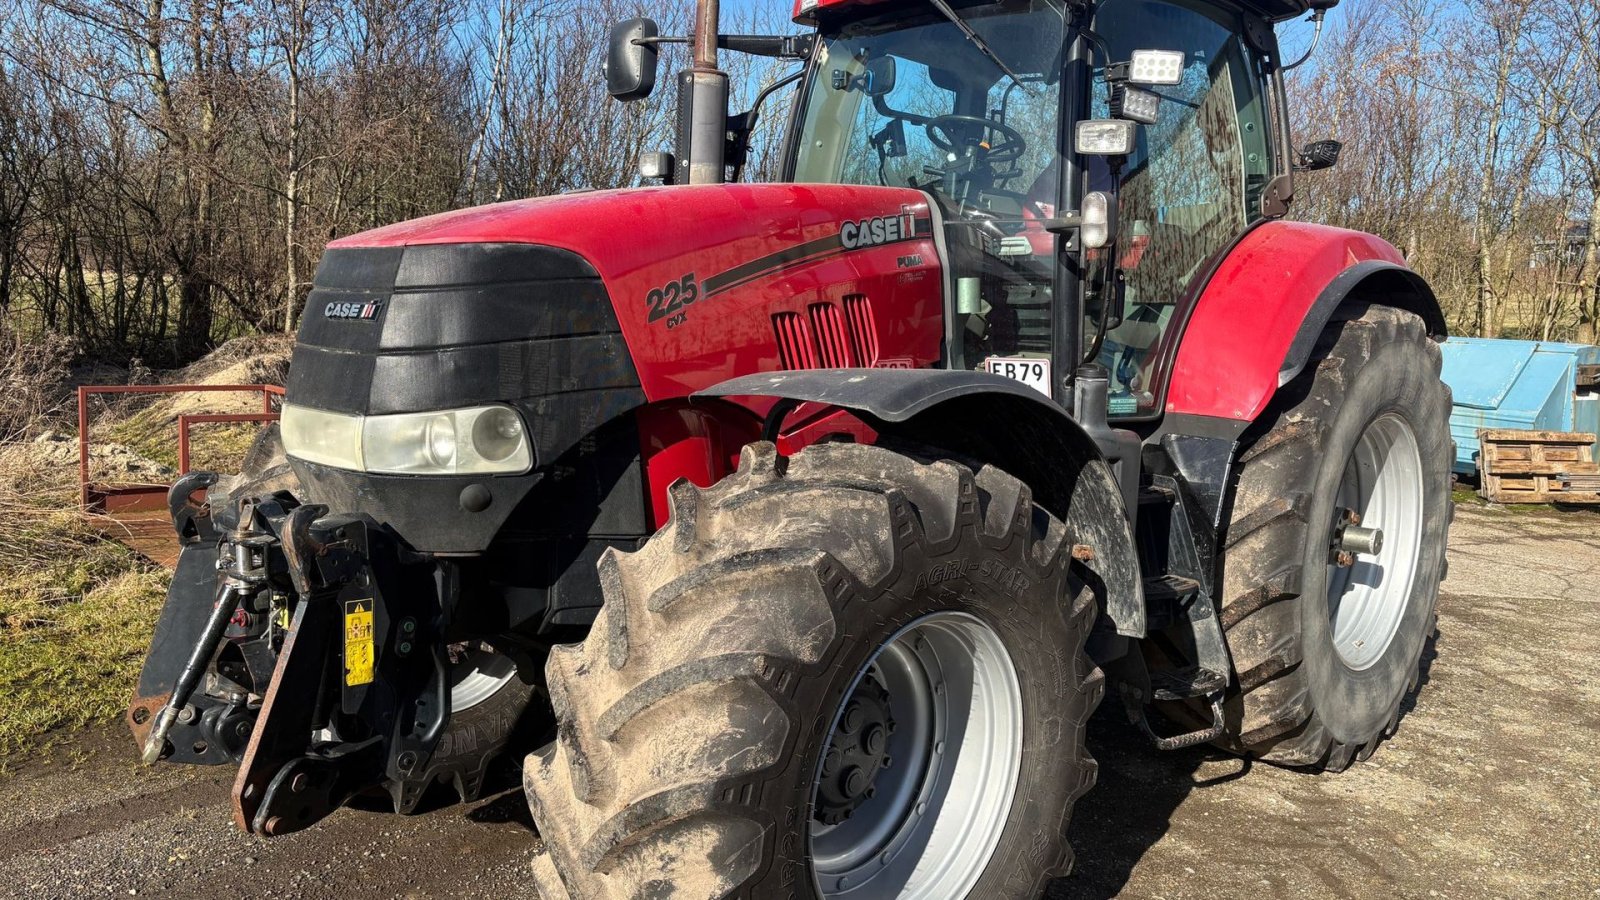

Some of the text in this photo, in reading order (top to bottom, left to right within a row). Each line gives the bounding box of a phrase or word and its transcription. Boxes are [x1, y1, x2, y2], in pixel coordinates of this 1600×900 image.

[840, 216, 898, 249] CASE
[896, 254, 923, 268] PUMA
[324, 302, 361, 318] CASE
[645, 271, 698, 324] 225
[666, 311, 687, 329] CVX
[911, 557, 1032, 598] AGRI-STAR
